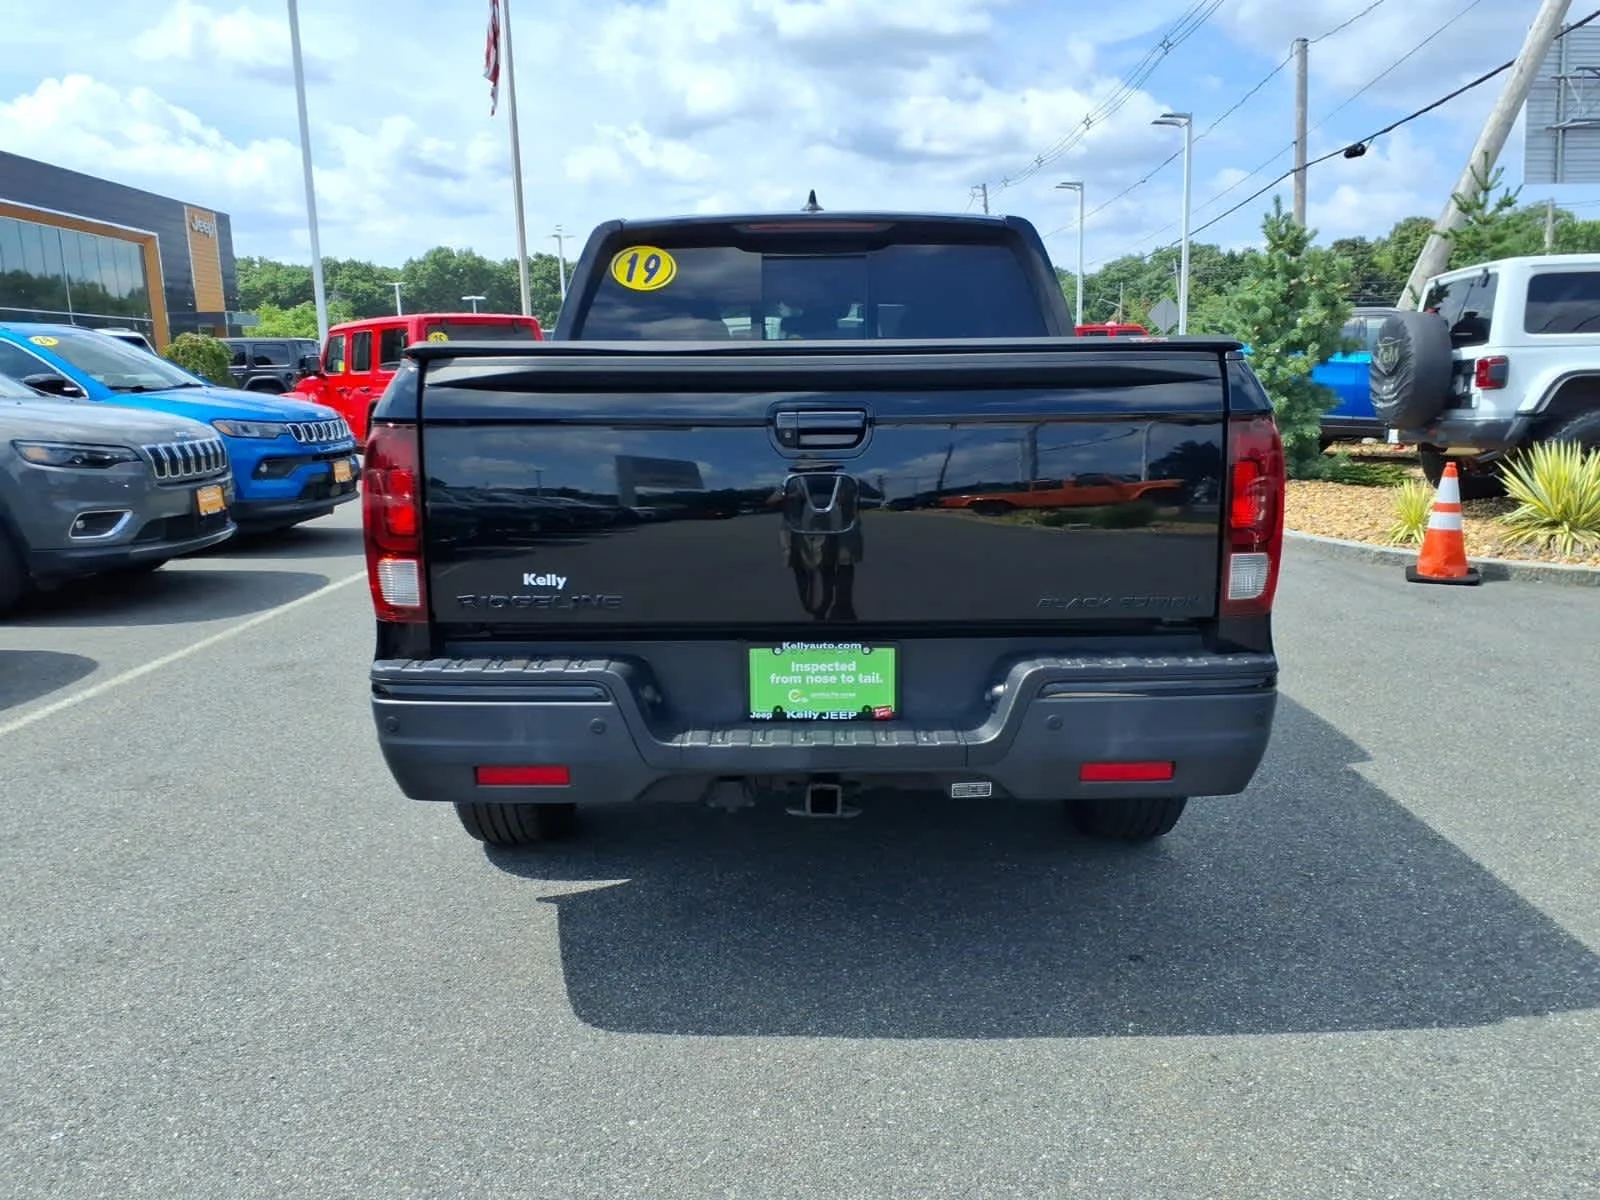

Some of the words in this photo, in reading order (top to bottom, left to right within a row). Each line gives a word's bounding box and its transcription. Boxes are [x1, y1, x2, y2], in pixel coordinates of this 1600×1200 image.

[191, 215, 217, 238] Jeep
[626, 252, 661, 283] 19
[523, 573, 567, 589] Kelly
[456, 594, 623, 608] RIDGELINE
[782, 641, 862, 651] Kellyauto.com
[791, 661, 857, 673] Inspected
[770, 674, 802, 684] from
[806, 675, 837, 684] nose
[841, 674, 855, 684] to
[858, 672, 883, 684] tail.
[750, 711, 773, 720] Jeep
[786, 711, 819, 720] Kelly
[822, 711, 857, 720] JEEP
